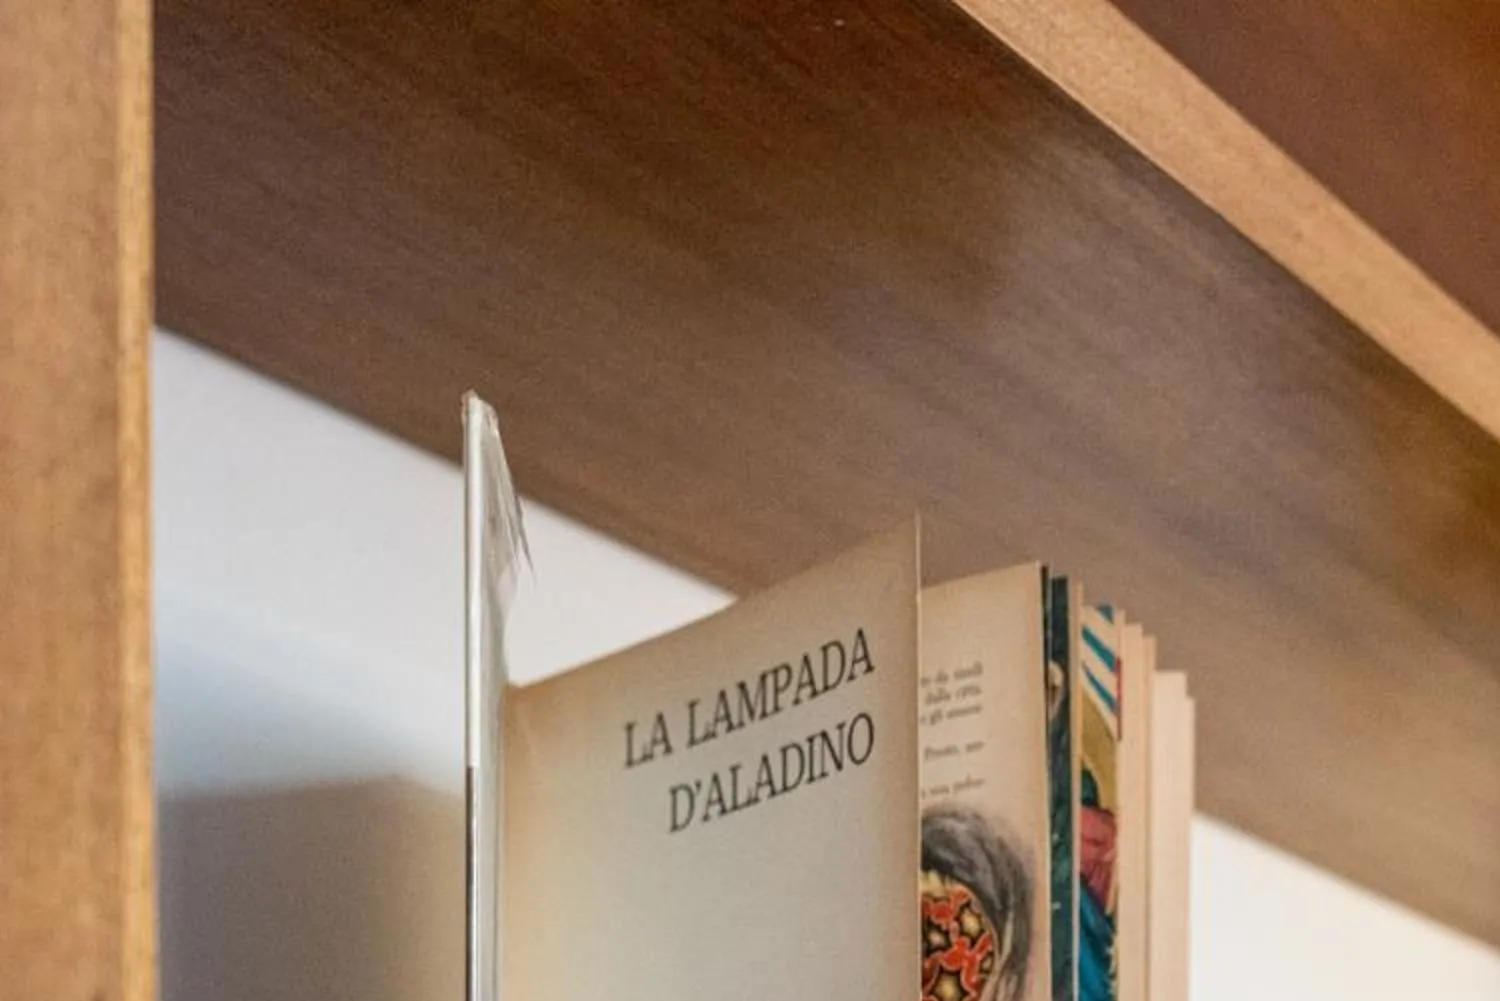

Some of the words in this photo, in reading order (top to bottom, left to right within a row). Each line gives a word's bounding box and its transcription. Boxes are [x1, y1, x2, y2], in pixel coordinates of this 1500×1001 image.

[623, 711, 673, 769] LA
[686, 627, 876, 750] LAMPADA
[668, 711, 876, 834] D'ALADINO
